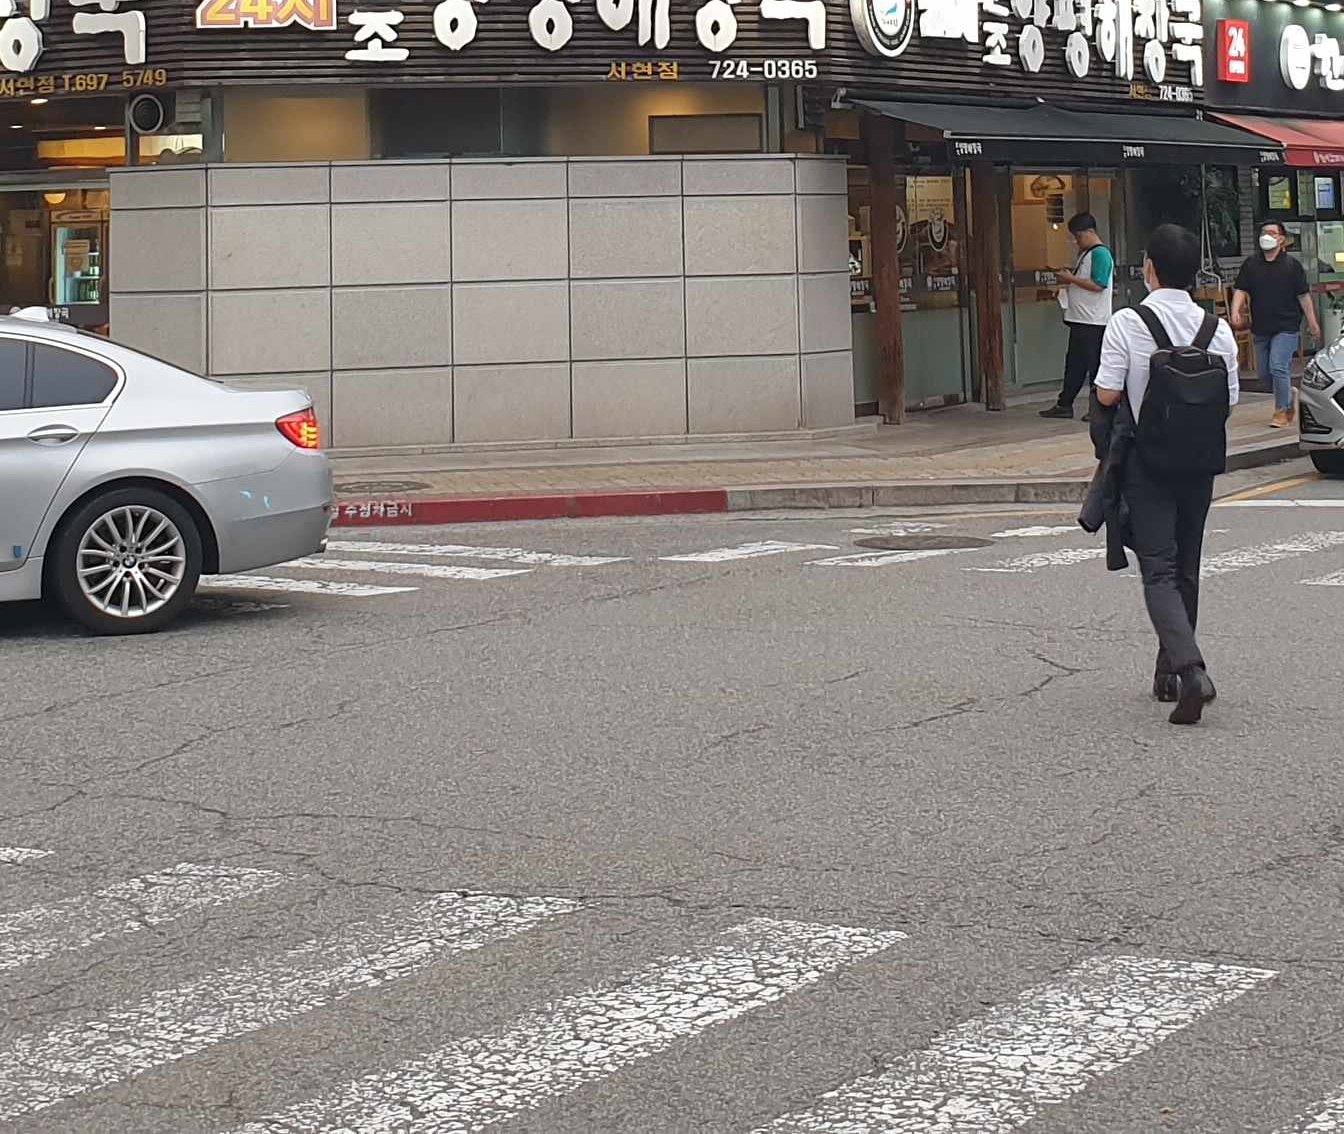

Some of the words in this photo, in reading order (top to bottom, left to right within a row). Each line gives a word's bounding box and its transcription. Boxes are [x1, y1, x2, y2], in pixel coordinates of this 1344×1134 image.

[123, 69, 166, 88] 5749
[607, 61, 679, 81] 서현점
[708, 59, 818, 80] 724-0365
